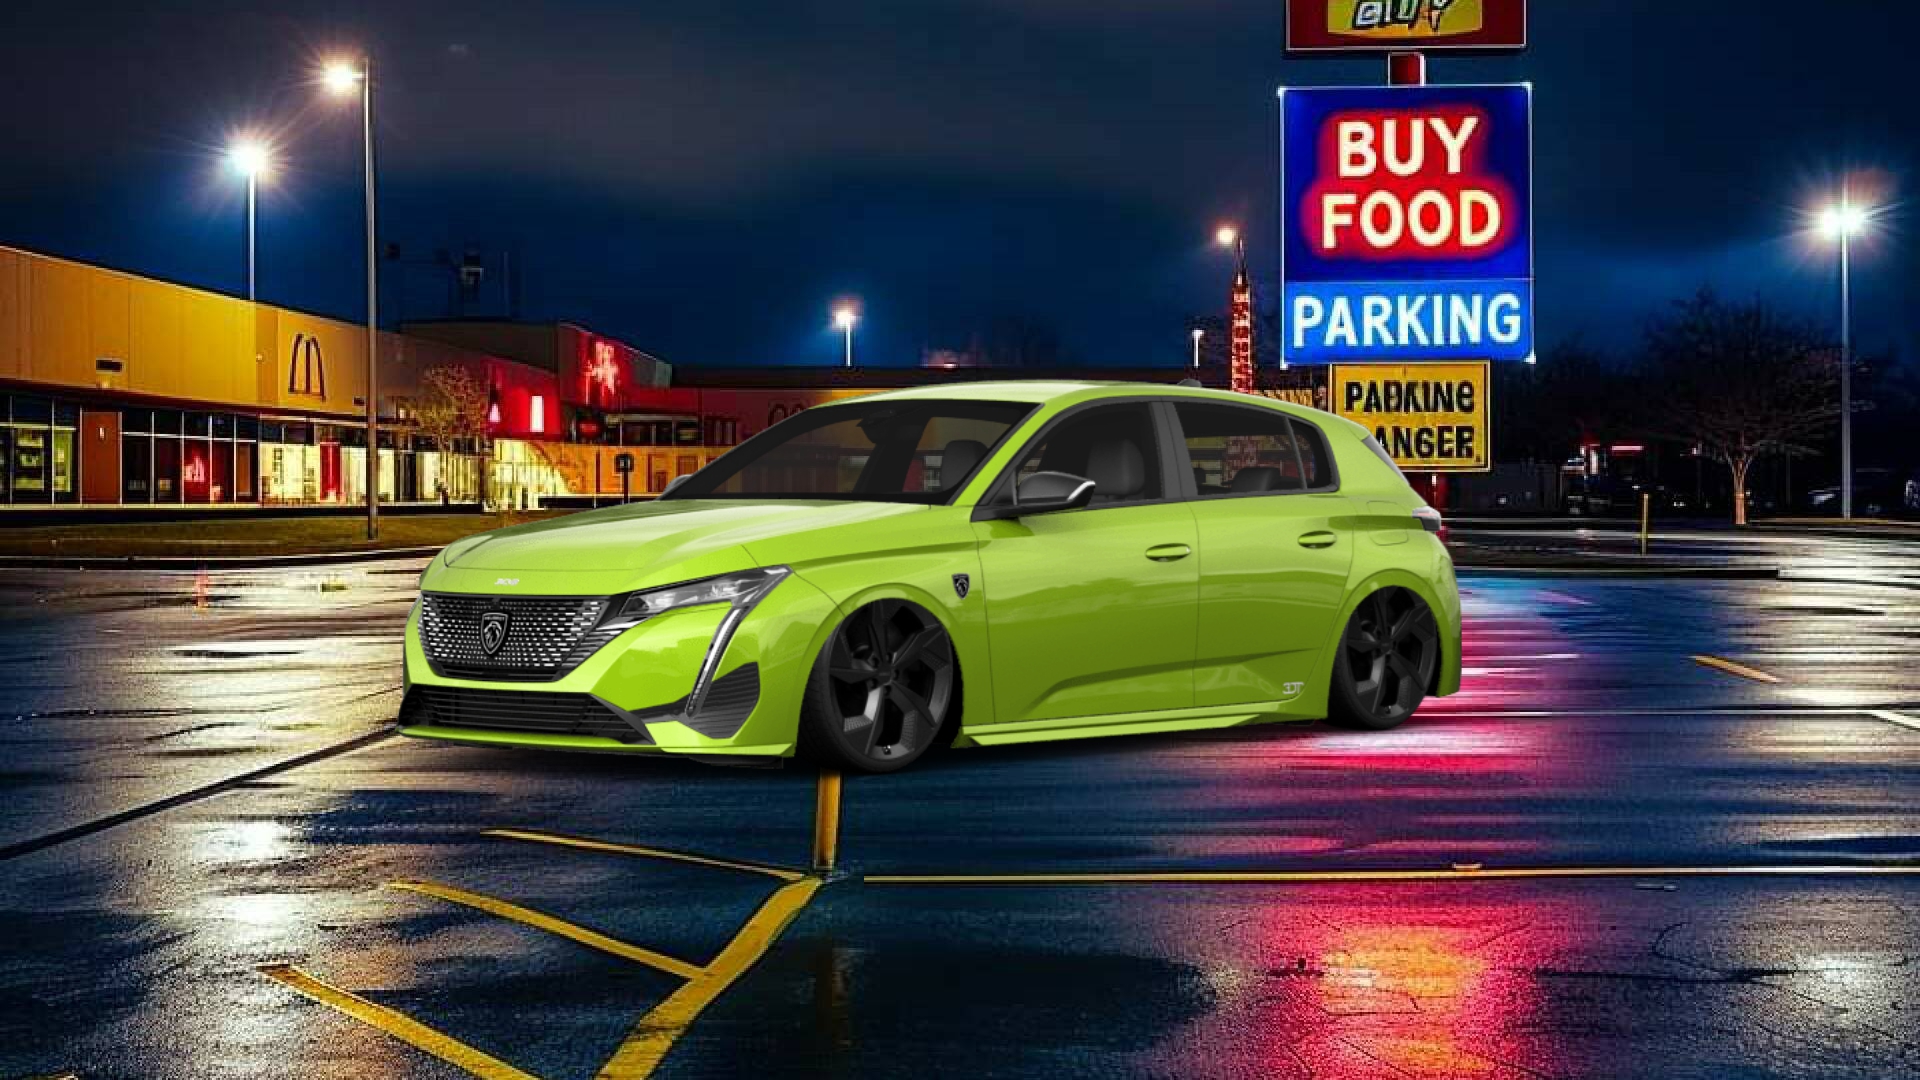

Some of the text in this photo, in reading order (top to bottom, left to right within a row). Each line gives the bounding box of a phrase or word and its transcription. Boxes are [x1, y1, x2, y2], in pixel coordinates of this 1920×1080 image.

[1338, 116, 1479, 177] BUY
[1321, 189, 1500, 249] FOOD
[1293, 293, 1521, 348] PARKING
